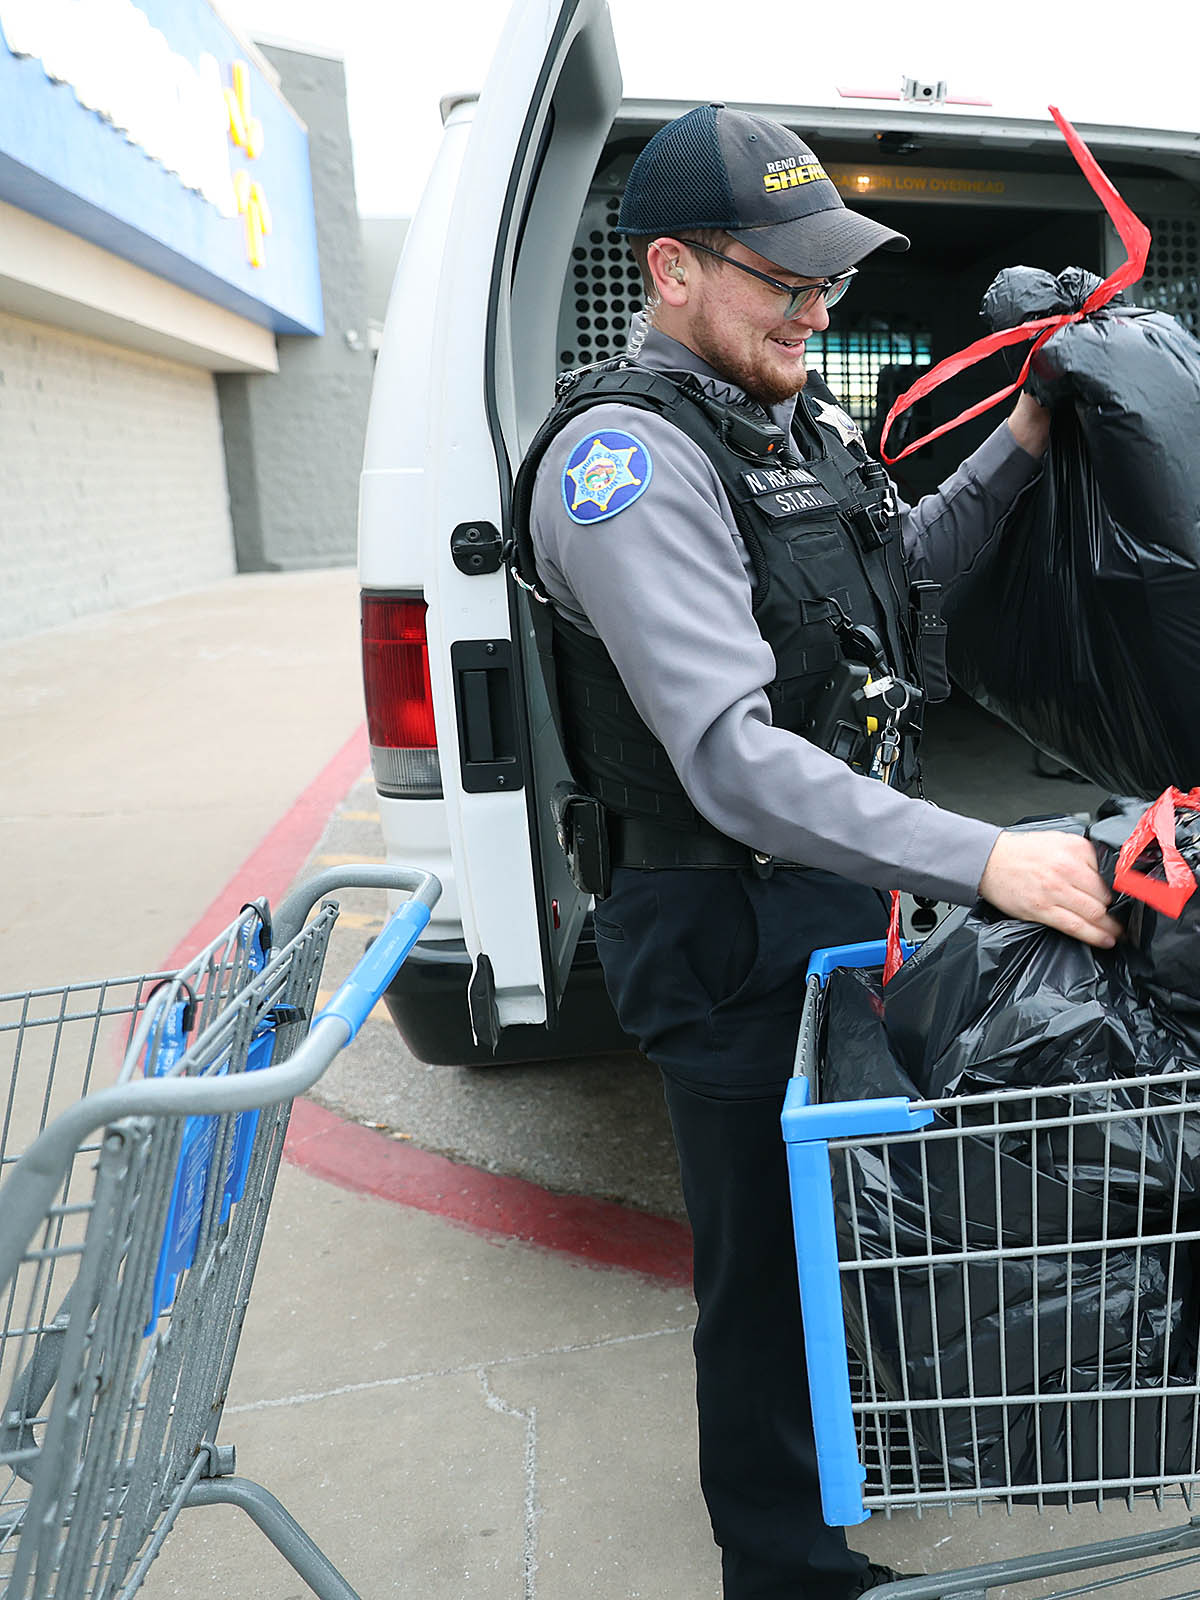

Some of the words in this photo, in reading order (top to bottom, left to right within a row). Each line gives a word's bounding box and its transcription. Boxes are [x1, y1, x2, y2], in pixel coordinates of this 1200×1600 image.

[766, 157, 797, 173] RENO
[895, 176, 928, 191] LOW
[930, 177, 1005, 193] OVERHEAD
[745, 472, 767, 494] N.
